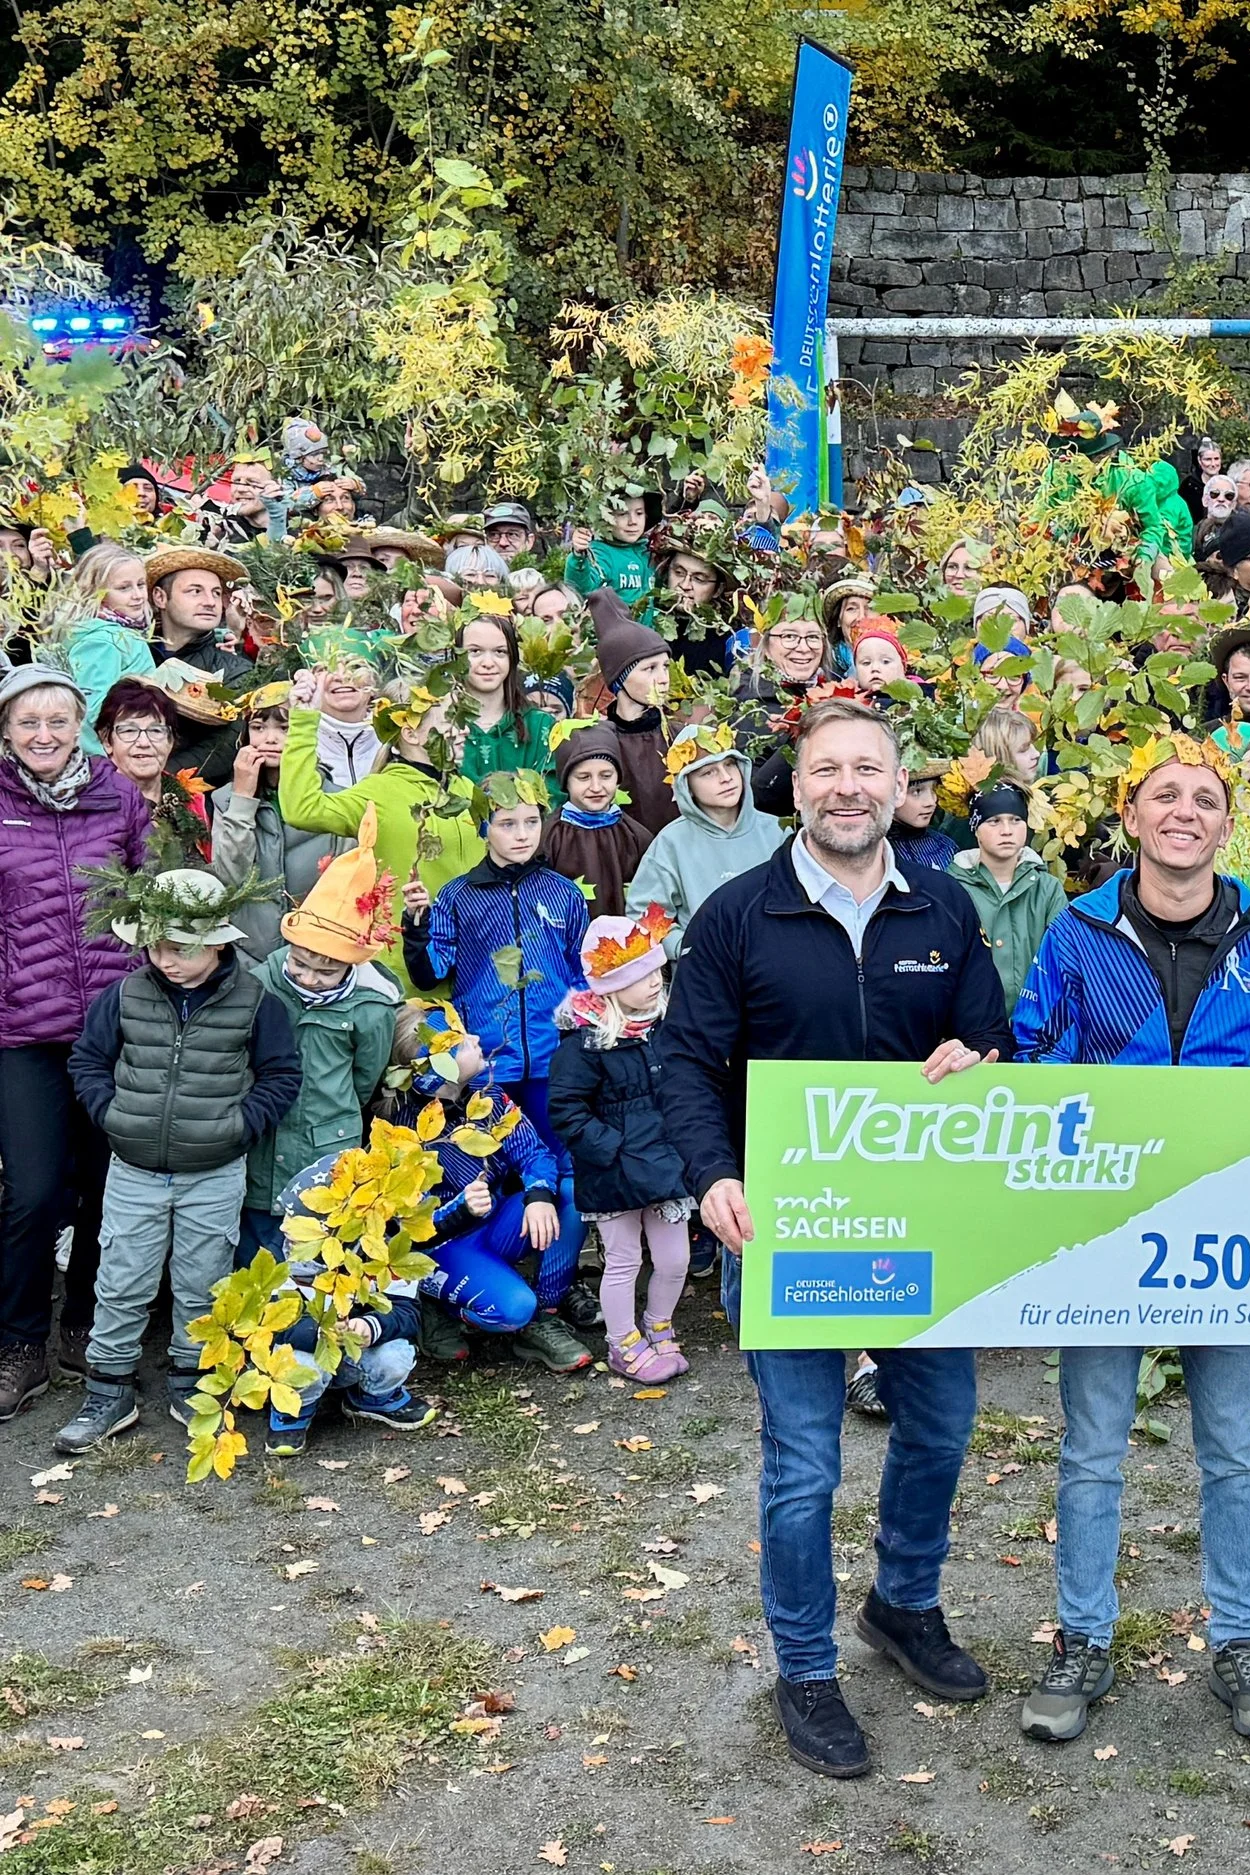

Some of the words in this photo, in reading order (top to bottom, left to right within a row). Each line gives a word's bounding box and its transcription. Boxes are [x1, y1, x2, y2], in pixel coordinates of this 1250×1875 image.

[774, 1187, 850, 1213] mdr
[775, 1216, 907, 1239] SACHSEN
[785, 1286, 905, 1303] Fernsehlotterie
[796, 1280, 836, 1288] DEUTSCHE
[1019, 1303, 1053, 1326] für
[1056, 1303, 1130, 1325] deinen
[1137, 1304, 1204, 1325] Verein
[1208, 1304, 1230, 1325] in
